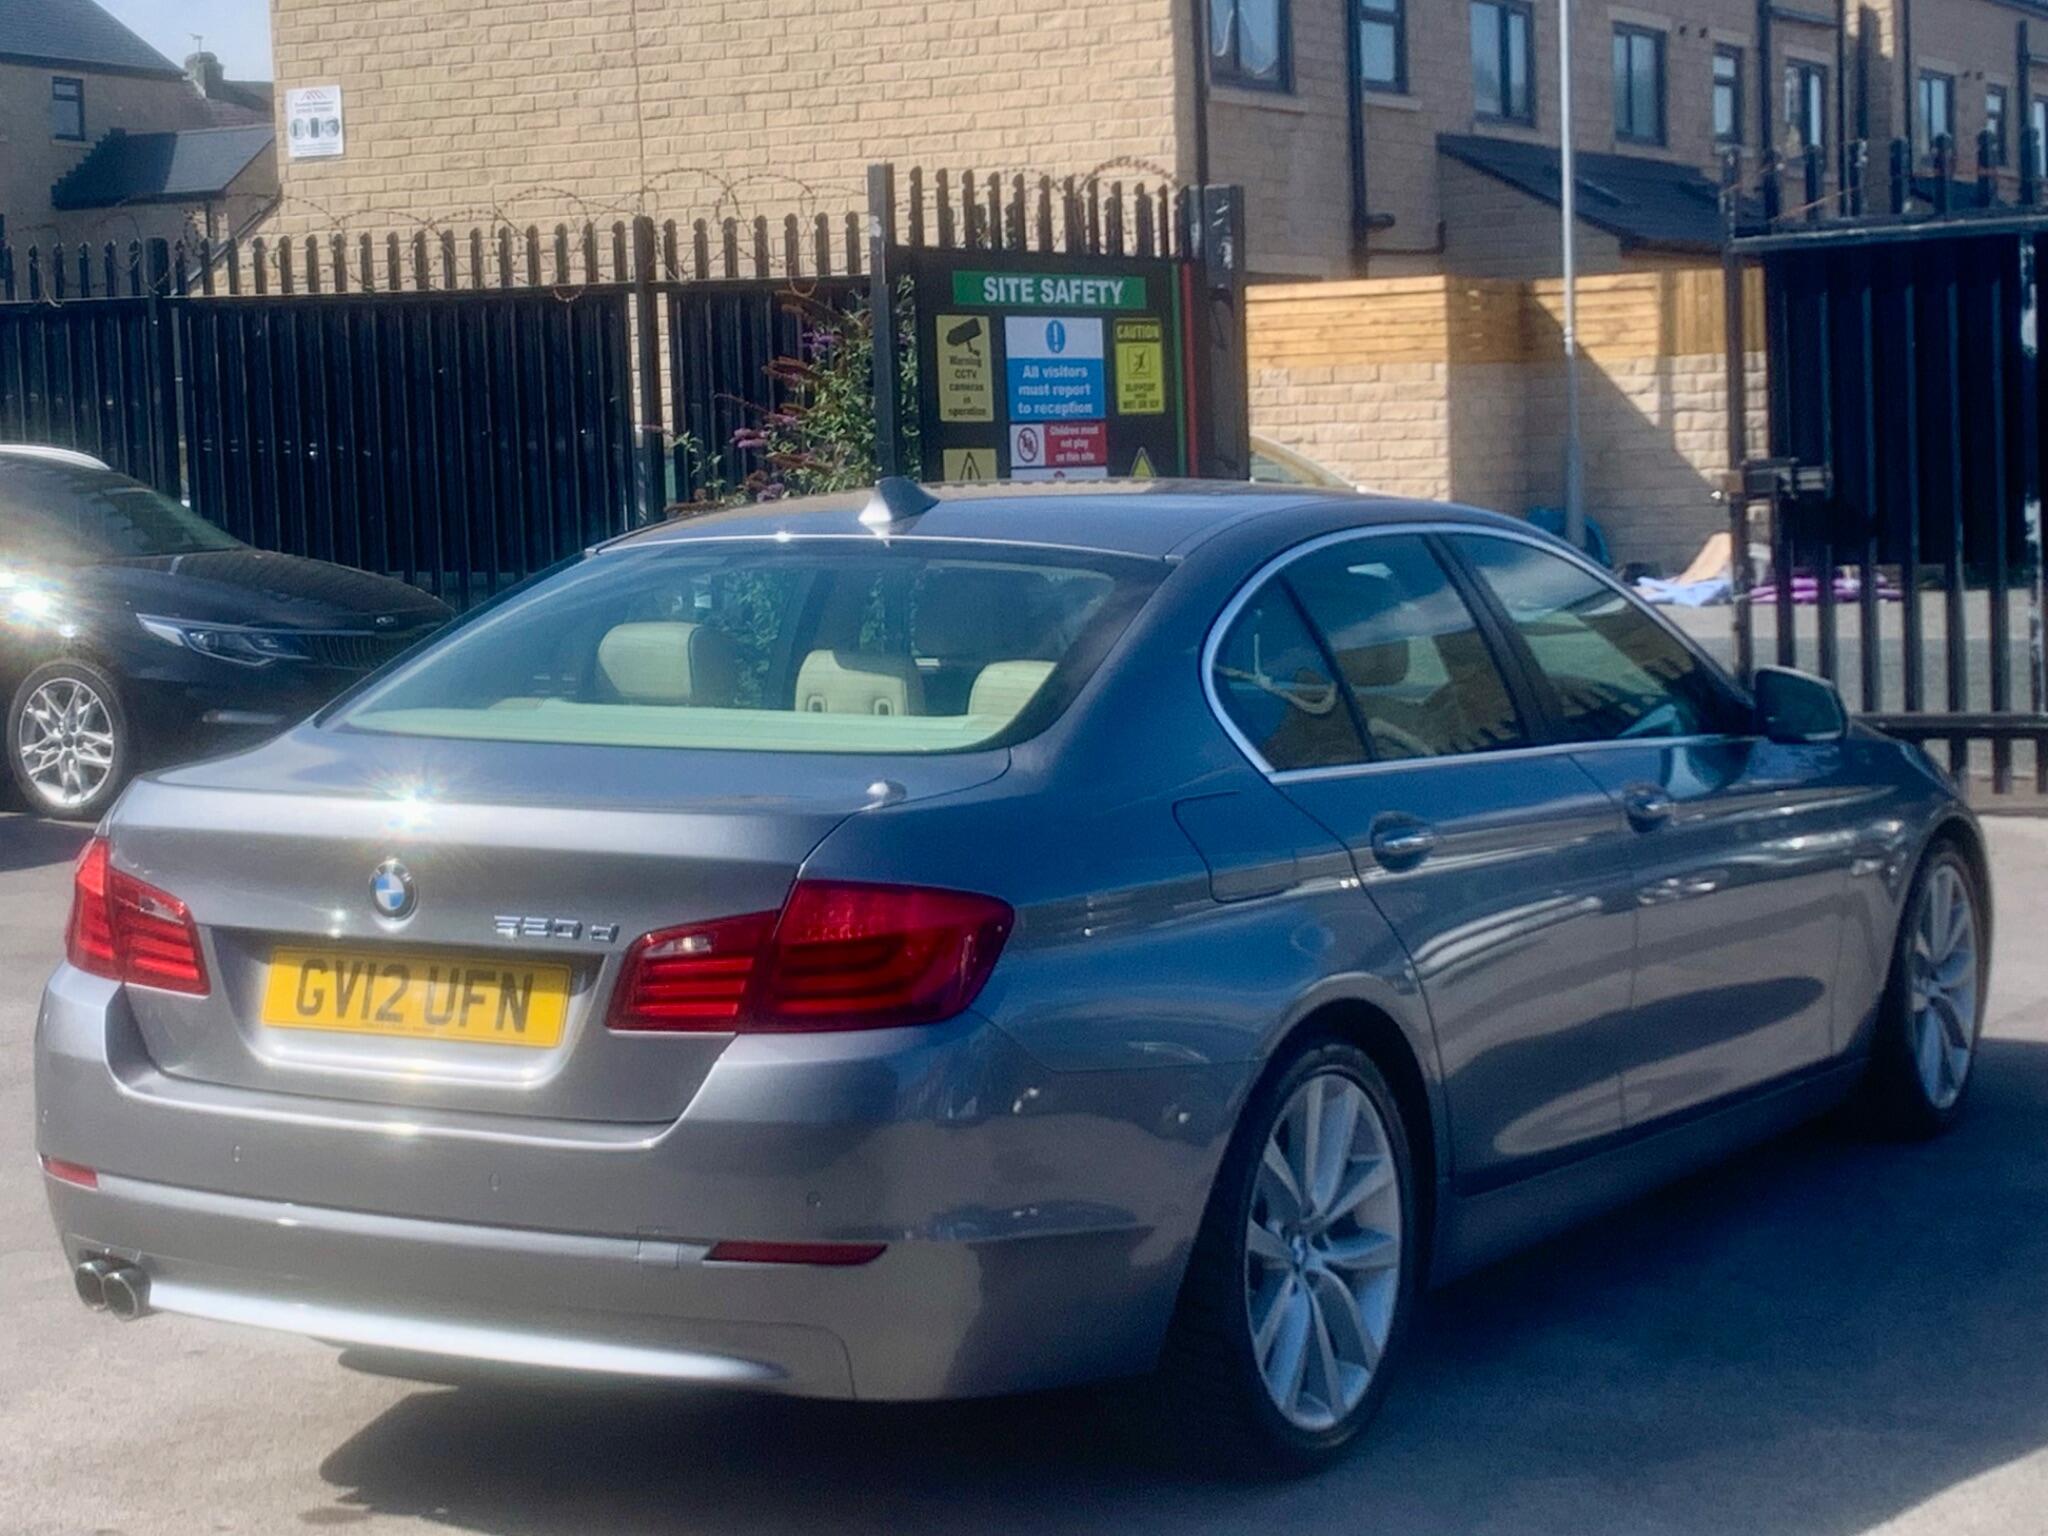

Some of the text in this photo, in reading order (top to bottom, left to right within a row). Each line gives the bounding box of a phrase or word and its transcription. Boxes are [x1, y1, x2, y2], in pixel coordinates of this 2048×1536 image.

[983, 276, 1124, 305] SITE SAFETY
[954, 368, 978, 380] CCTV
[1022, 364, 1088, 379] All visitors
[1018, 383, 1091, 399] must report
[1017, 400, 1094, 417] to reception
[295, 958, 534, 1034] GV12 UFN
